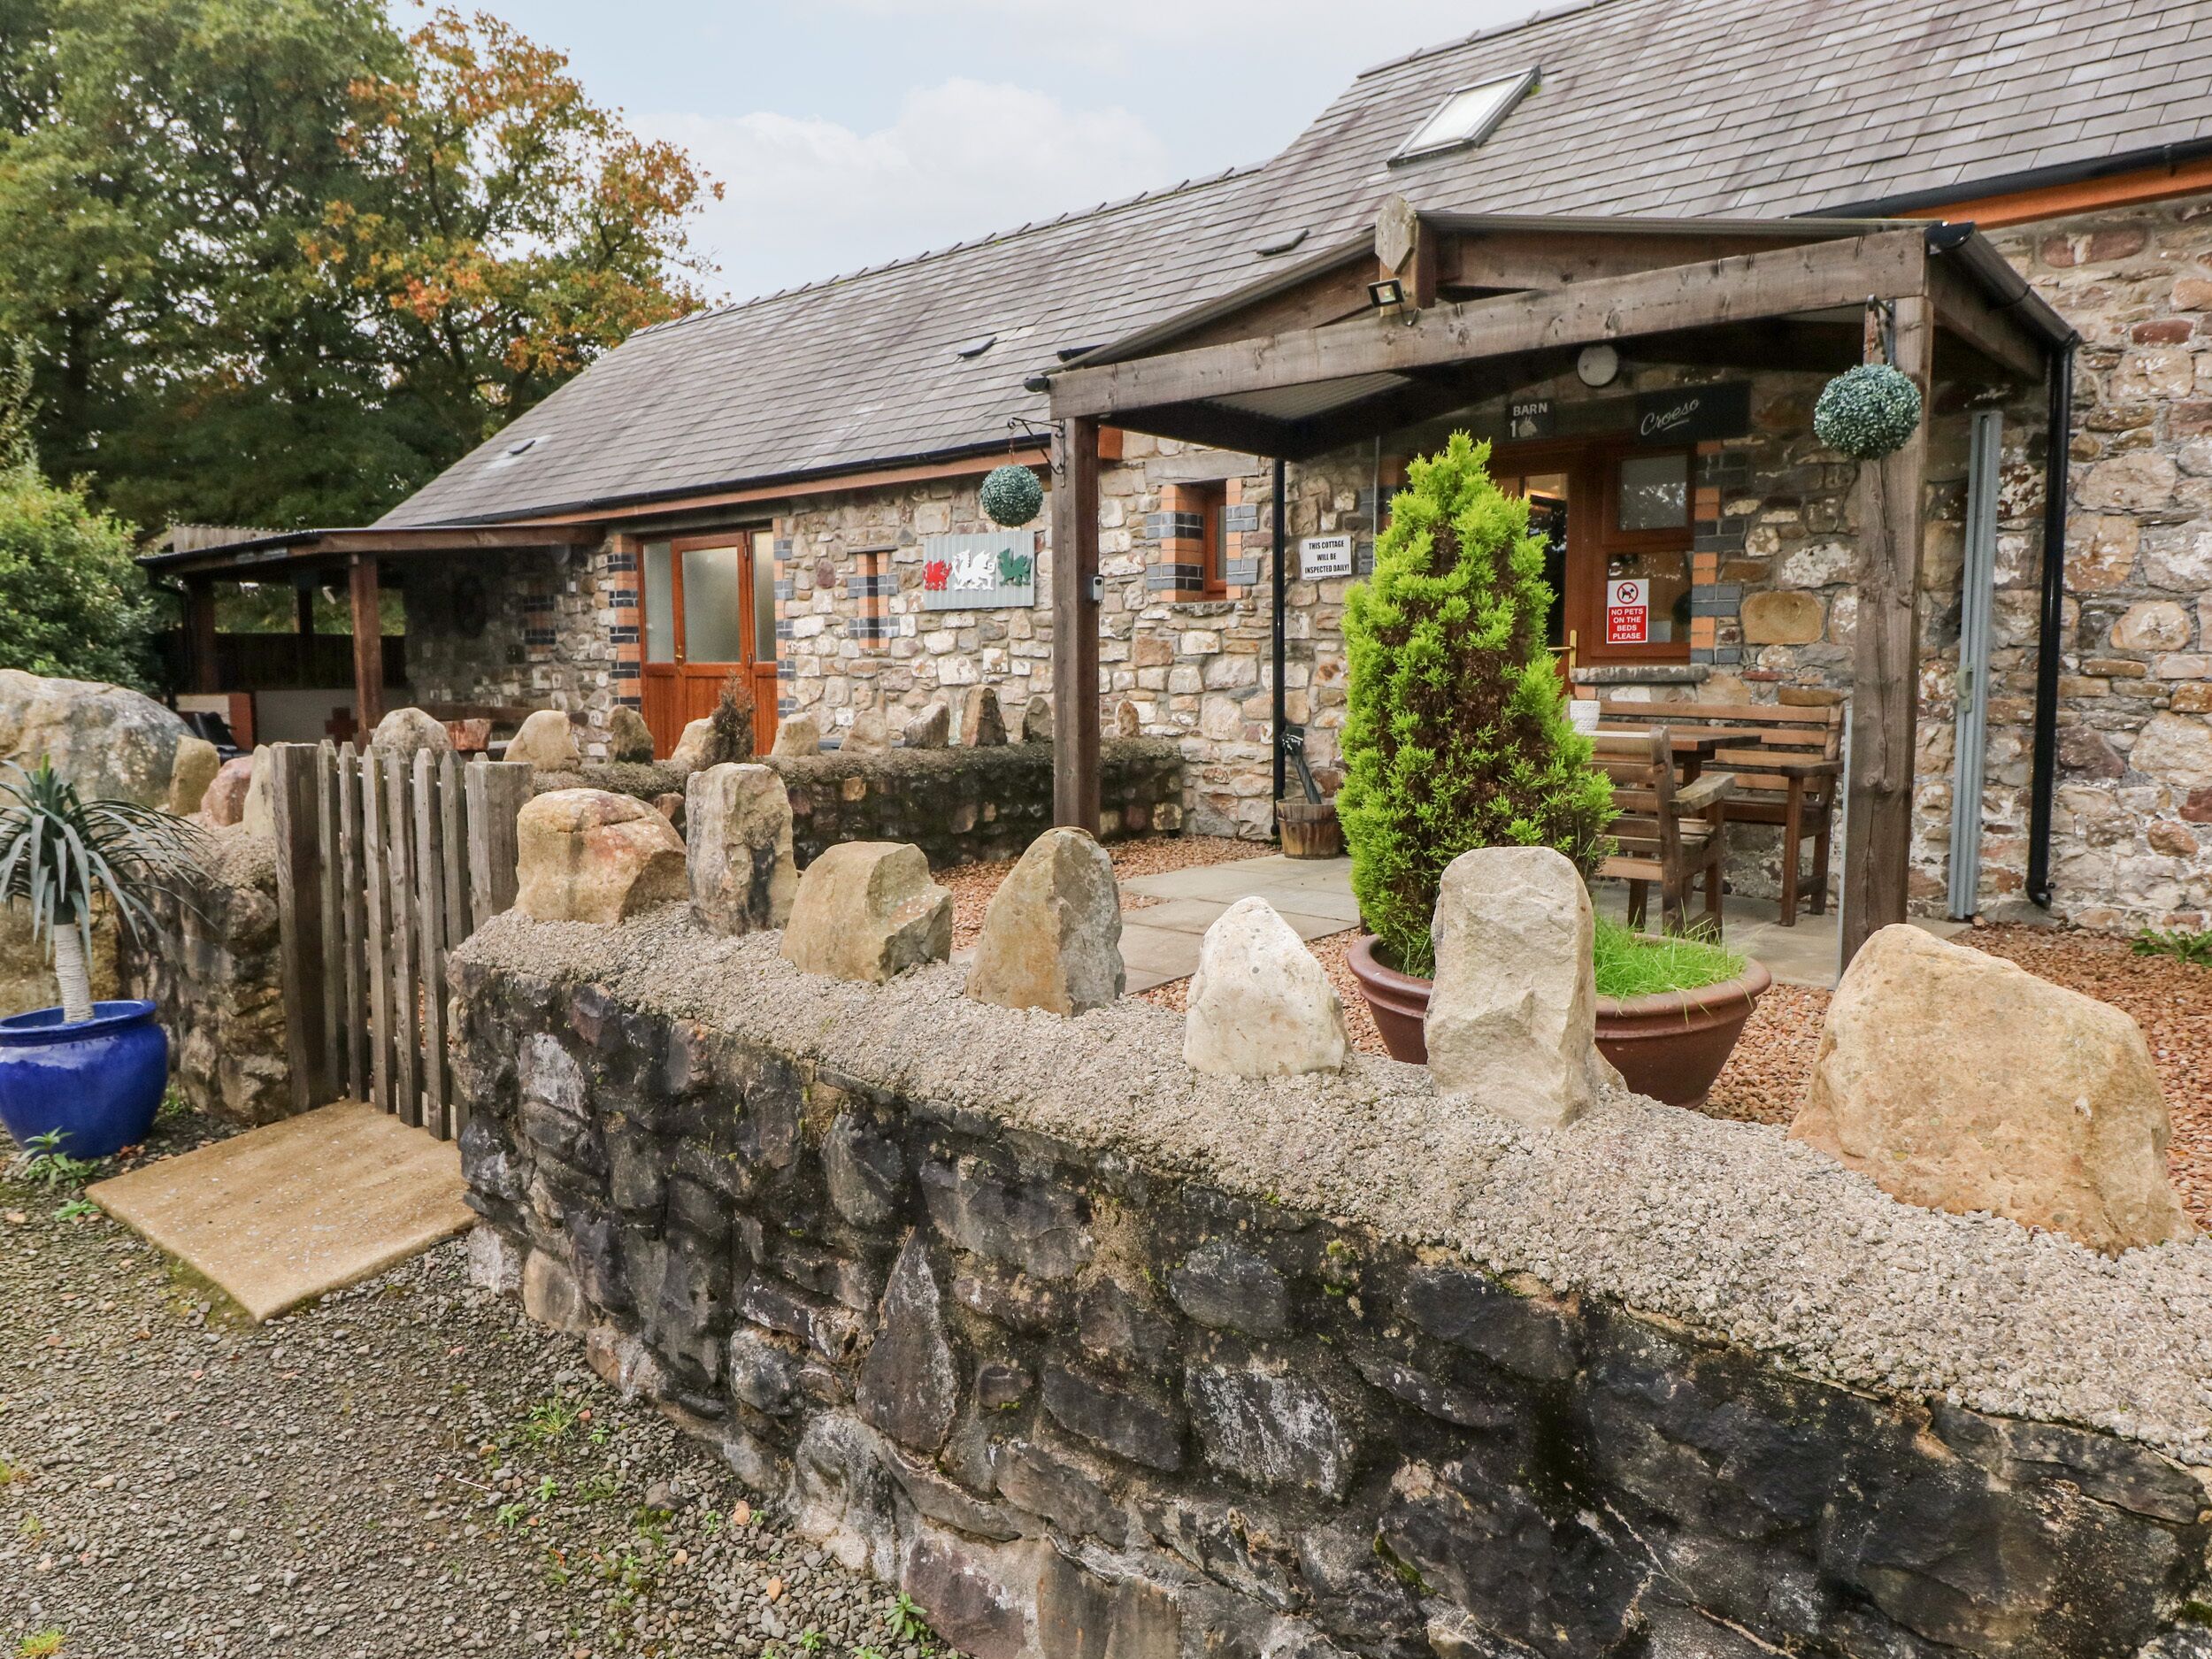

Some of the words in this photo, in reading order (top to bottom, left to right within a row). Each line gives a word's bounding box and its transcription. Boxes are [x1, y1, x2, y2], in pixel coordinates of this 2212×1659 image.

[1513, 402, 1548, 417] BARN
[1640, 398, 1700, 436] Croeso
[1509, 419, 1517, 437] 1
[1321, 540, 1344, 549] COTTAGE
[1304, 565, 1332, 574] INSPECTED
